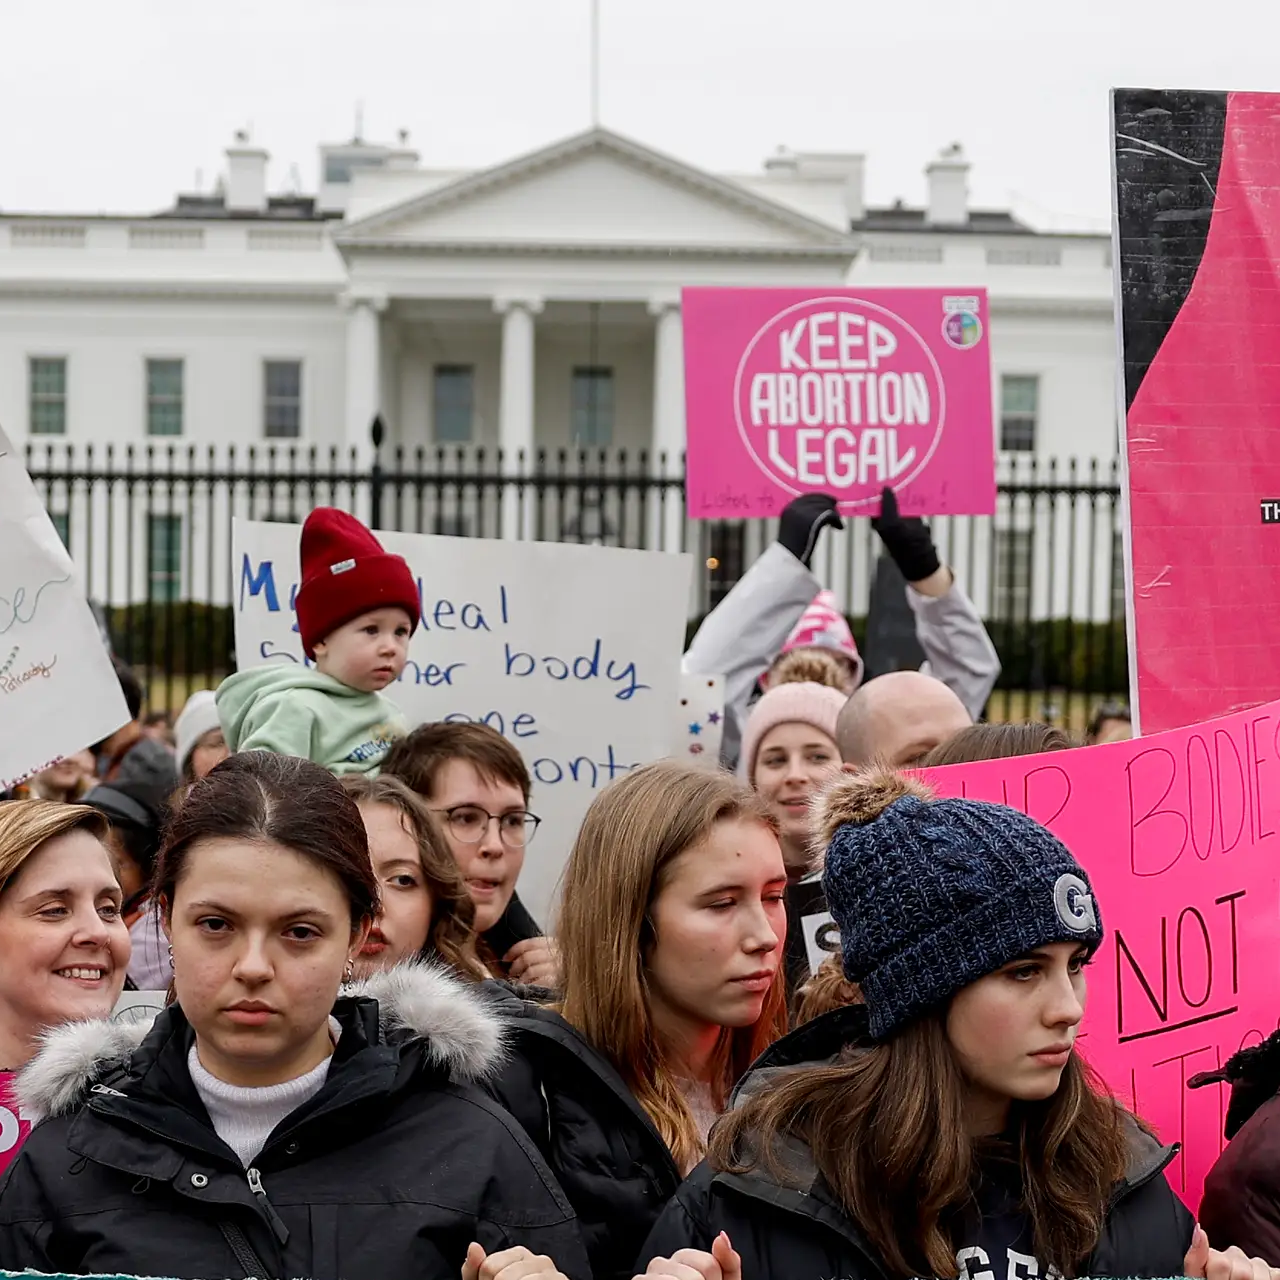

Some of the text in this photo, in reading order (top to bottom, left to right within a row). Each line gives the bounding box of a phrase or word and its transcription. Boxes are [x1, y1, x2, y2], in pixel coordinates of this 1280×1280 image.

[779, 311, 897, 369] KEEP
[750, 371, 930, 426] ABORTION
[767, 427, 916, 487] LEGAL
[505, 639, 651, 700] body
[1053, 873, 1097, 934] G
[1115, 890, 1246, 1034] NOT
